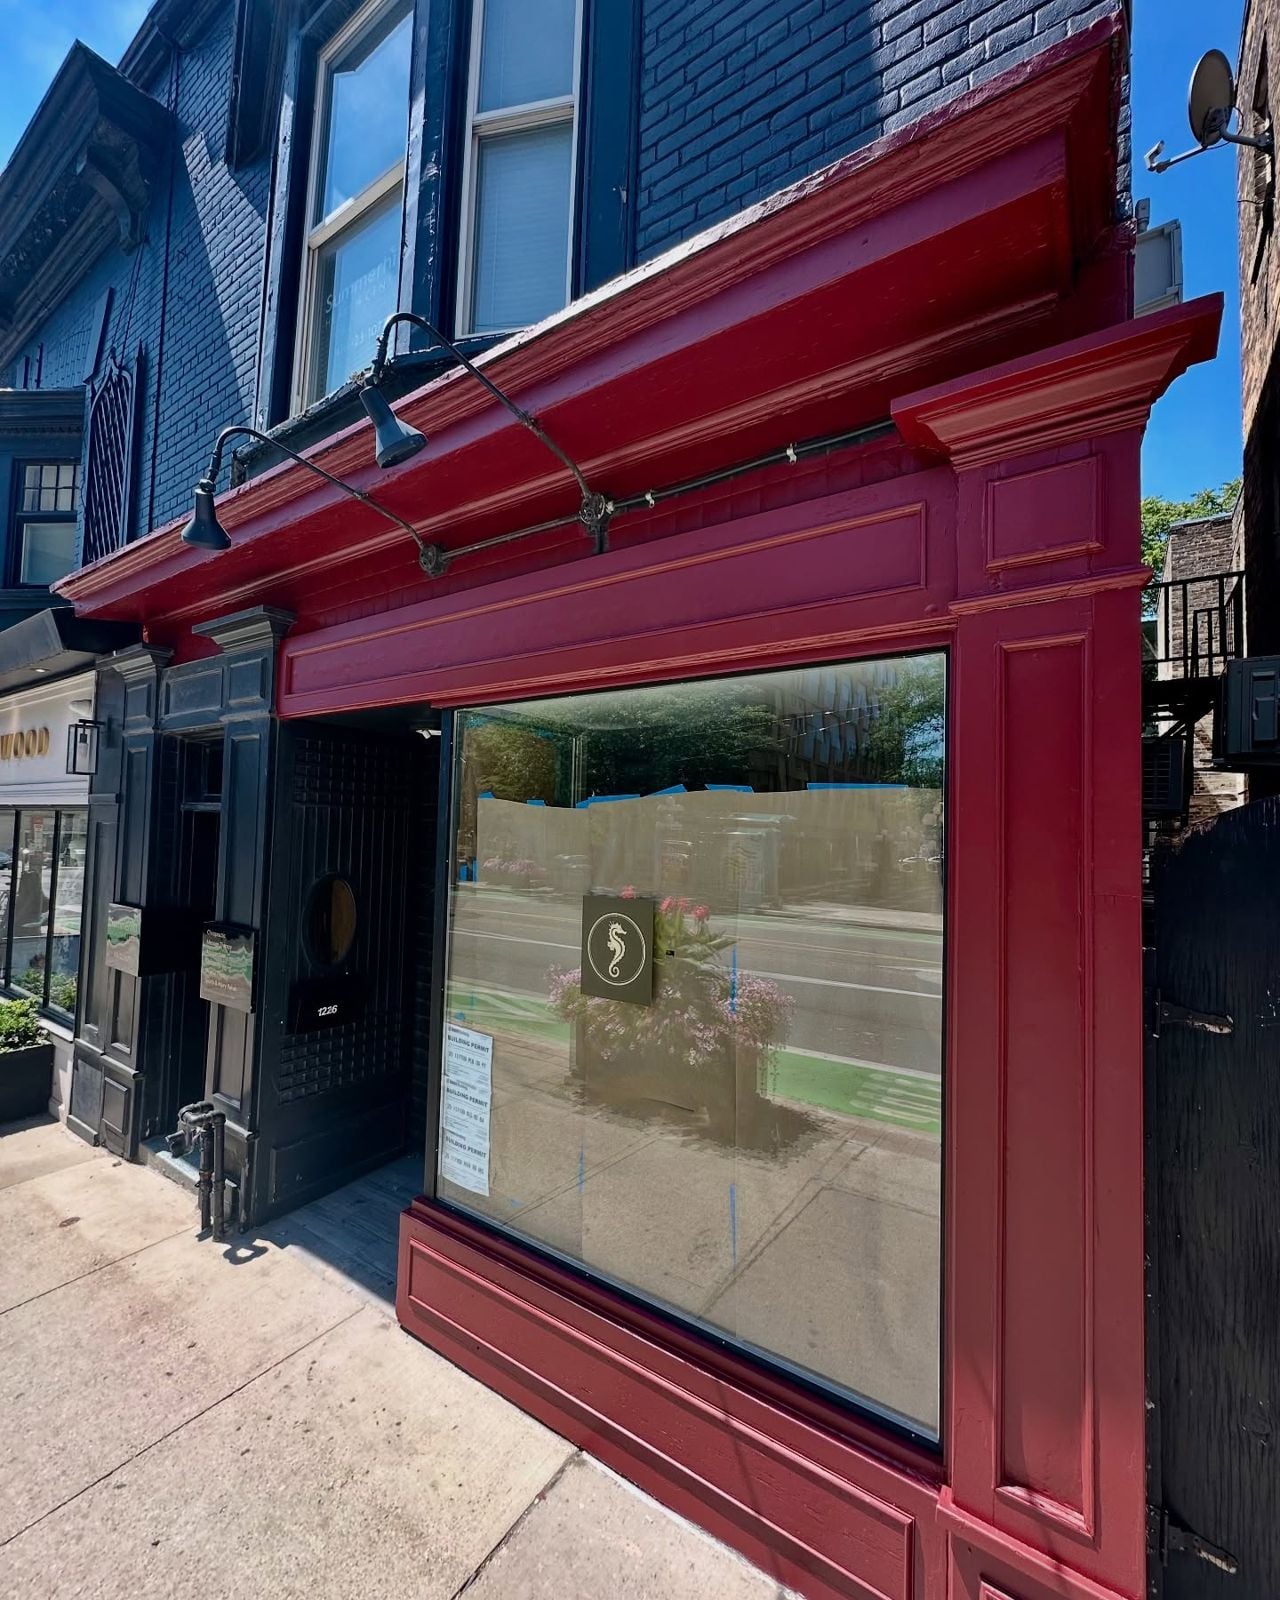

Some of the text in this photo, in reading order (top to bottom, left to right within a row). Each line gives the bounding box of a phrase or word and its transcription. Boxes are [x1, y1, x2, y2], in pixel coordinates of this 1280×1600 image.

[317, 1004, 339, 1017] 1226
[448, 1034, 489, 1053] BUILDING PERMIT
[447, 1087, 488, 1108] BUILDING PERMIT
[446, 1136, 487, 1159] BUILDING PERMIT
